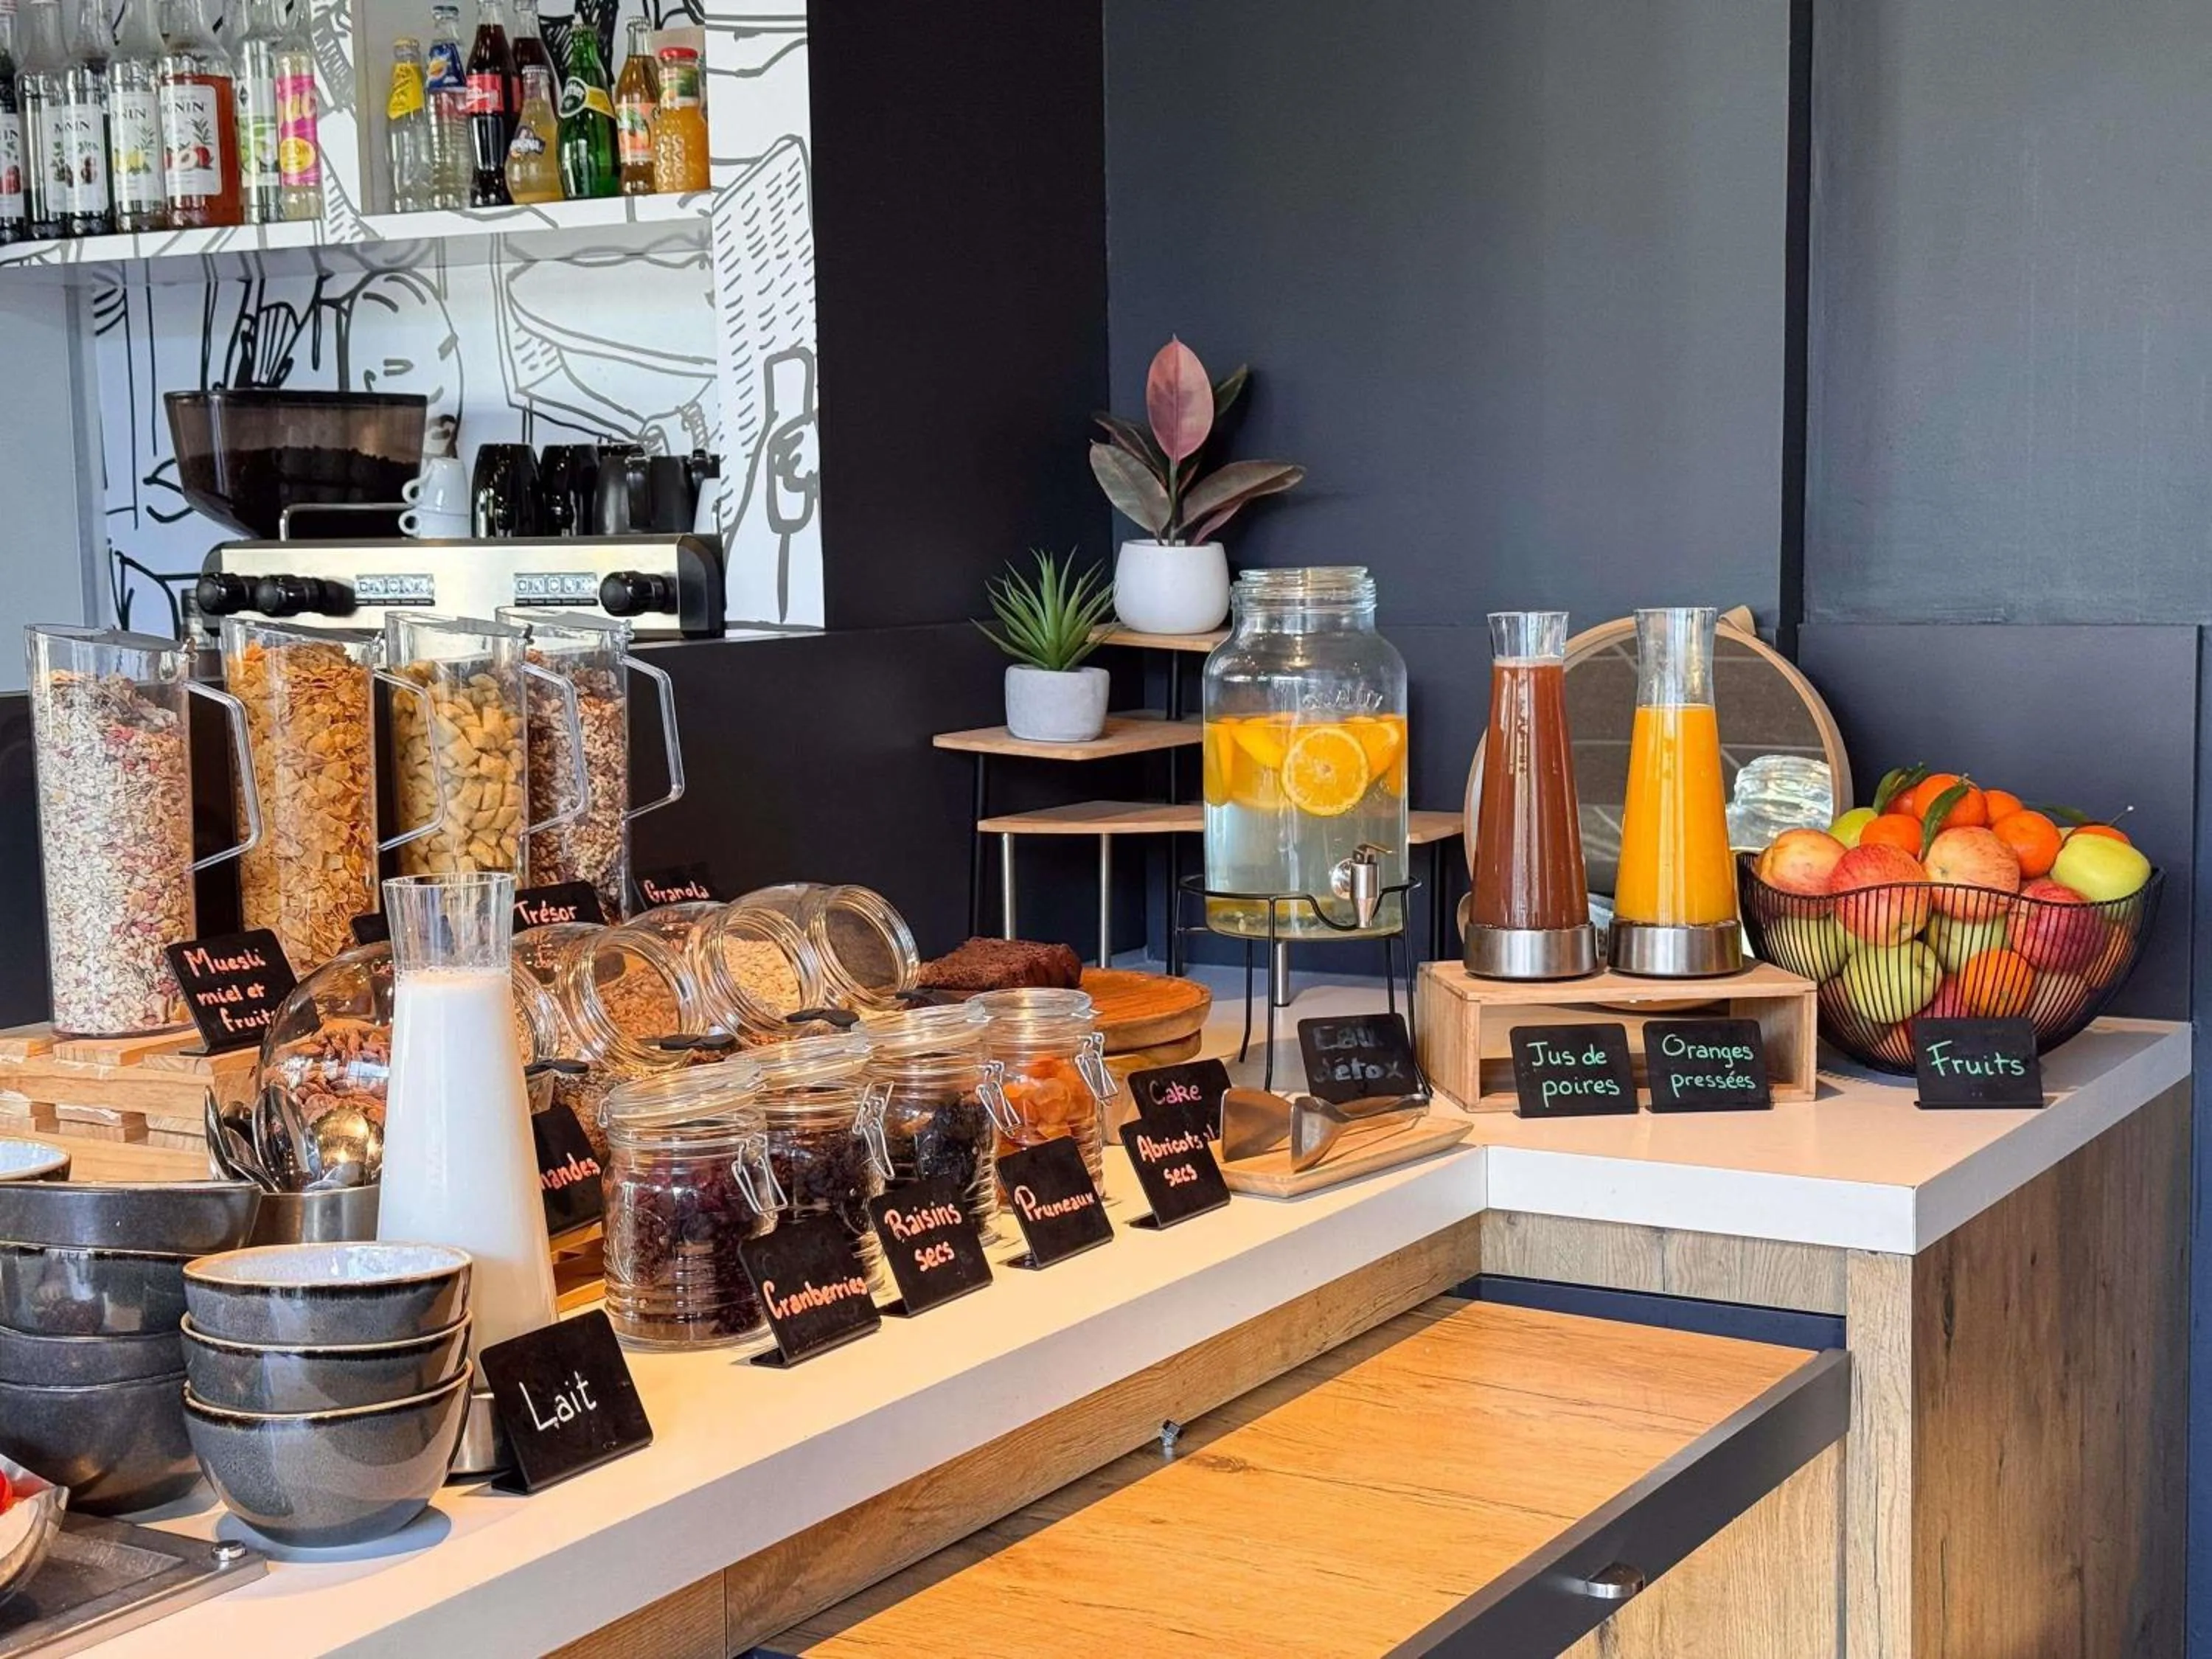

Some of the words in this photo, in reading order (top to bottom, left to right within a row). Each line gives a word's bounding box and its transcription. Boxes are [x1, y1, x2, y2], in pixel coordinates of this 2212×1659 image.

[644, 880, 709, 903] Granola
[514, 900, 577, 925] Trésor
[183, 947, 266, 977] Muesli
[196, 984, 243, 1006] miel
[247, 983, 265, 998] et
[220, 1007, 275, 1032] fruit
[1526, 1041, 1576, 1066] Jus
[1582, 1043, 1607, 1065] de
[1662, 1034, 1754, 1068] Oranges
[1926, 1040, 2025, 1077] Fruits
[1150, 1079, 1202, 1105] Cake
[1542, 1077, 1621, 1108] poires
[1670, 1070, 1756, 1098] pressées
[1136, 1130, 1203, 1163] Abricots
[1164, 1163, 1198, 1187] secs
[1015, 1185, 1095, 1222] Pruneaux
[885, 1201, 962, 1241] Raisins
[914, 1241, 955, 1272] secs
[763, 1276, 867, 1321] Cranberries
[519, 1371, 597, 1431] Lait
